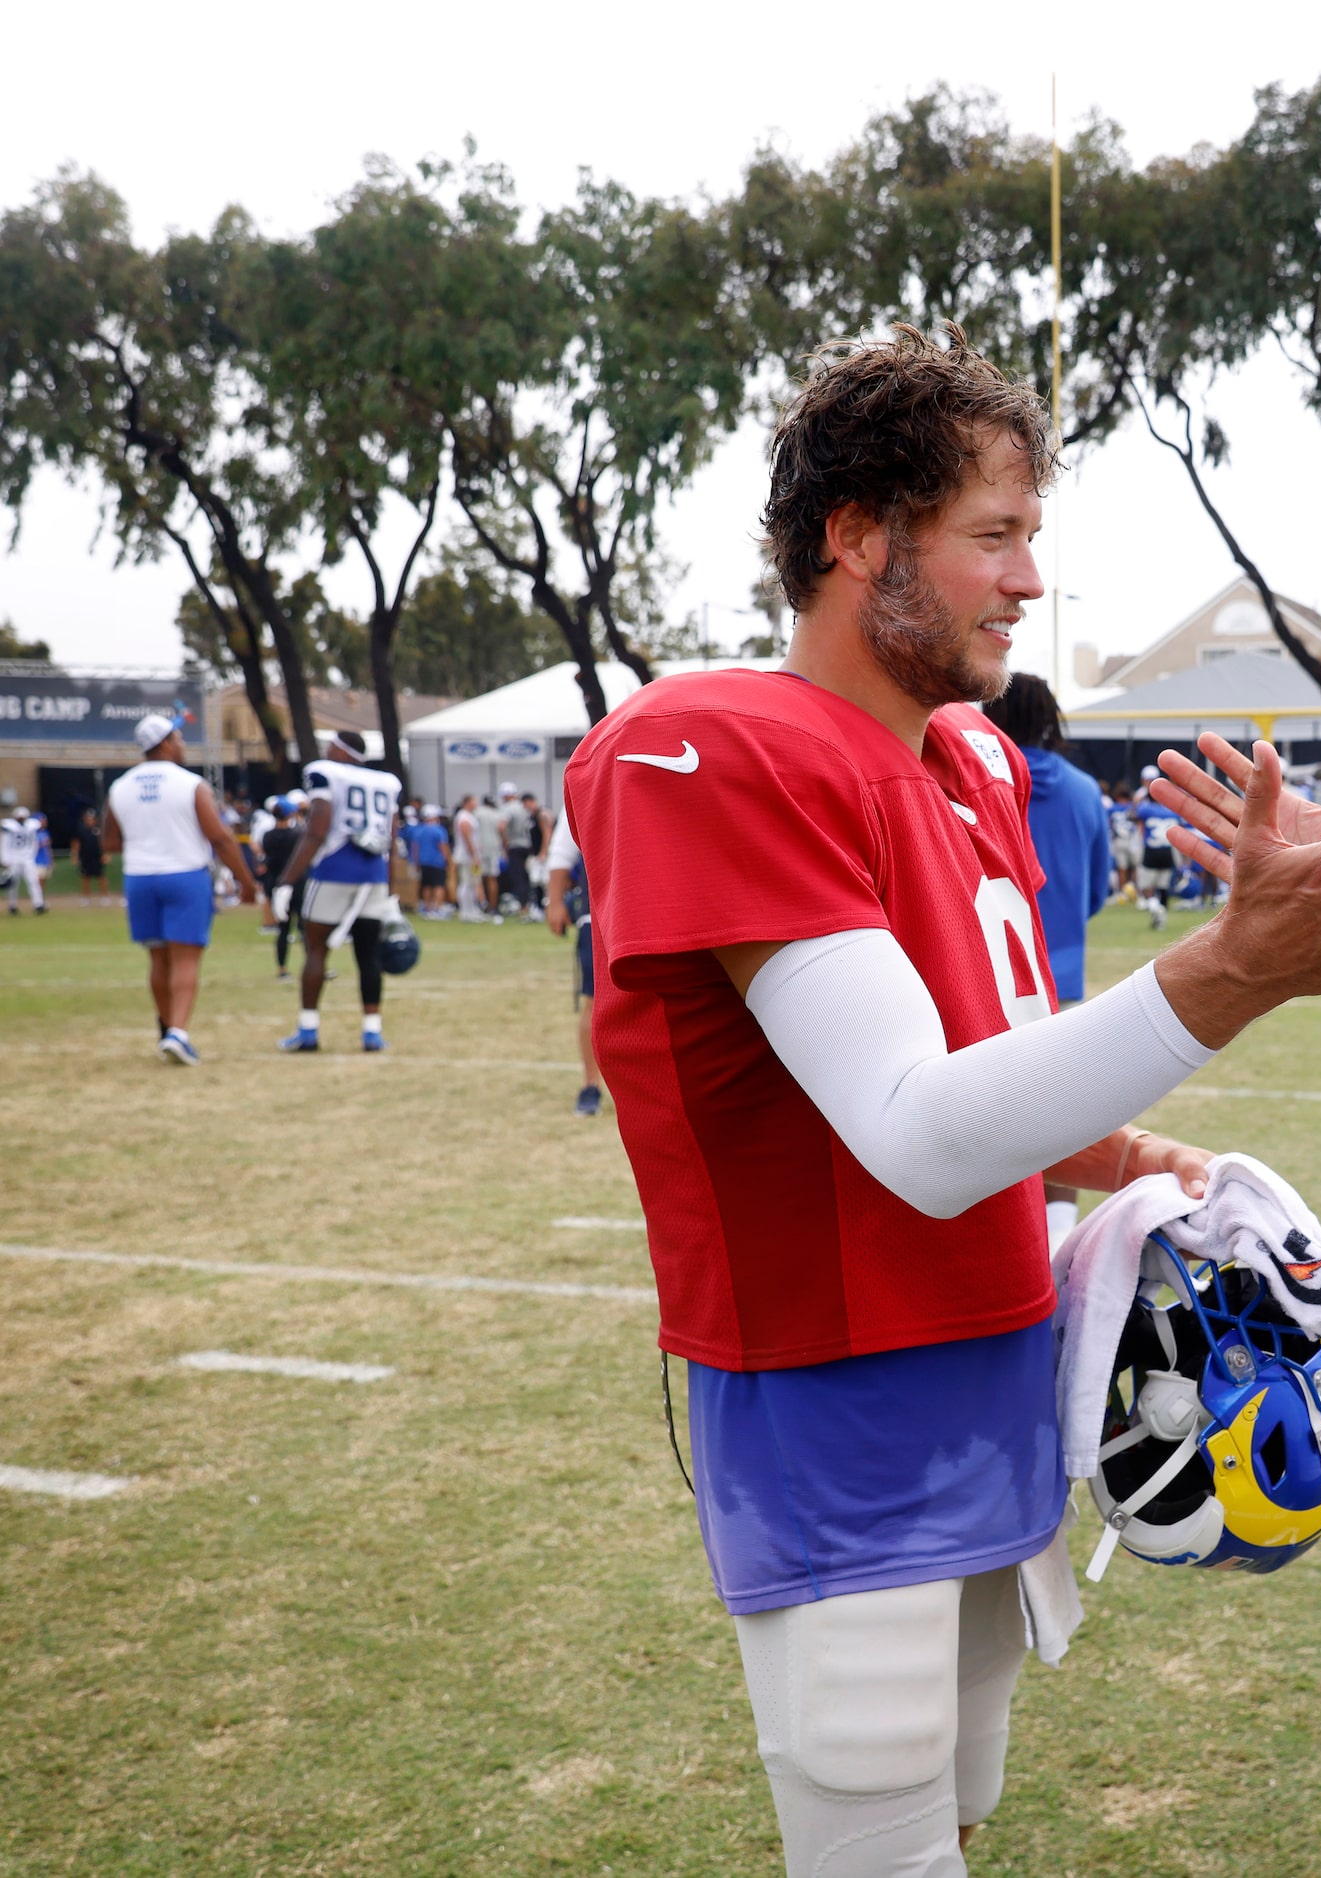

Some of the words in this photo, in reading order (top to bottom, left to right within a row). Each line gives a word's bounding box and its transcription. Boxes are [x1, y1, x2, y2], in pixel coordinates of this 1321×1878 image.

[25, 696, 91, 721] CAMP
[101, 703, 176, 720] American
[345, 786, 390, 834] 99
